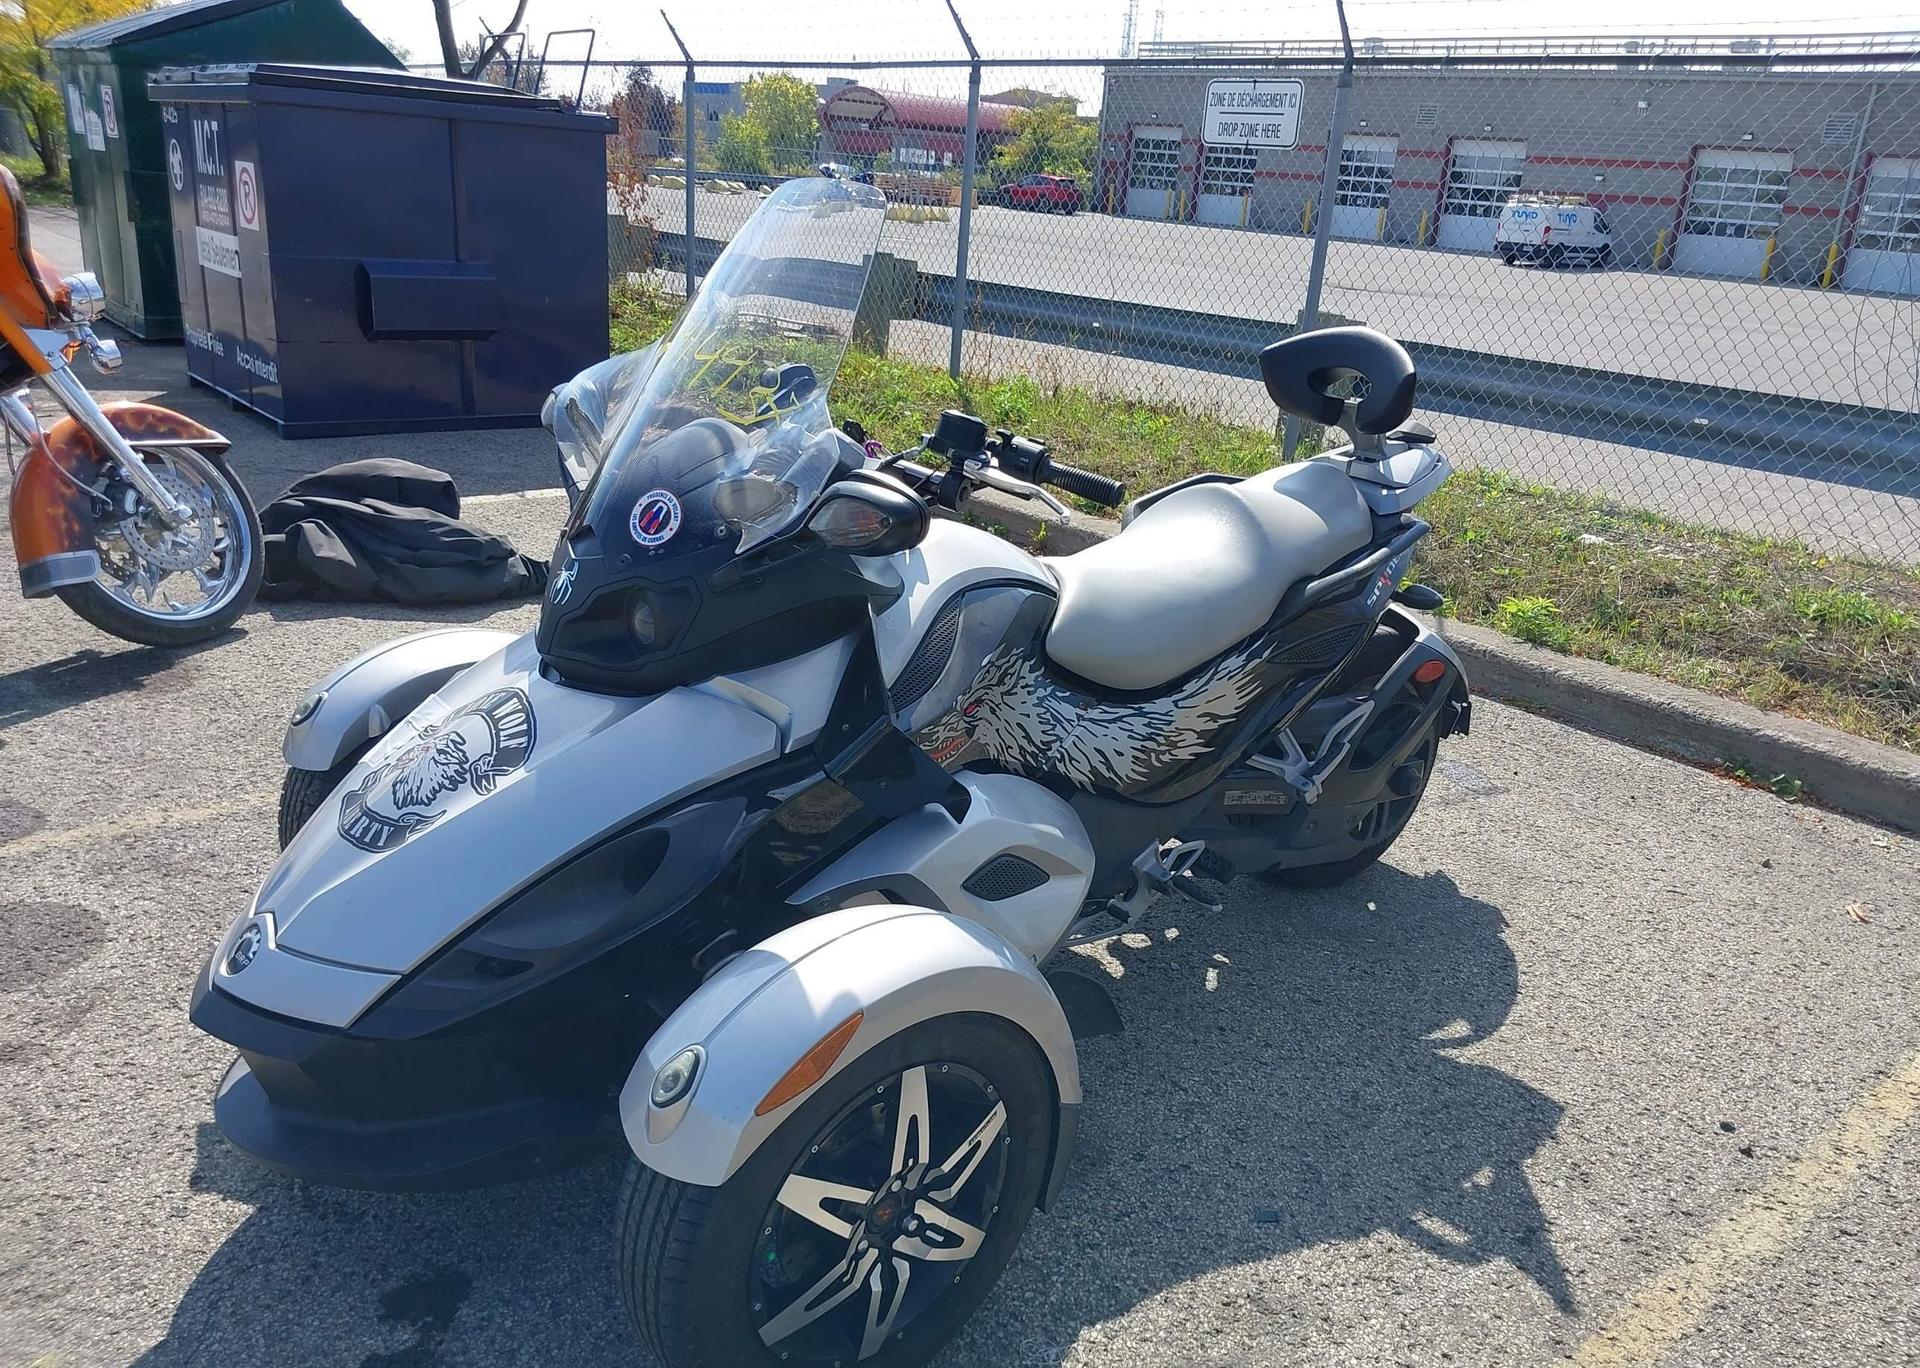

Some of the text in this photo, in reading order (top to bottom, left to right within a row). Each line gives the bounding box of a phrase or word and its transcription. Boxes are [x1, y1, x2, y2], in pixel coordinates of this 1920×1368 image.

[1210, 89, 1297, 109] ZONE DE DÉCHARGEMENT ICI
[1218, 122, 1282, 139] DROP ZONE HERE
[1366, 555, 1401, 608] SPYDE
[492, 697, 528, 749] WOLF
[235, 951, 250, 966] BRP
